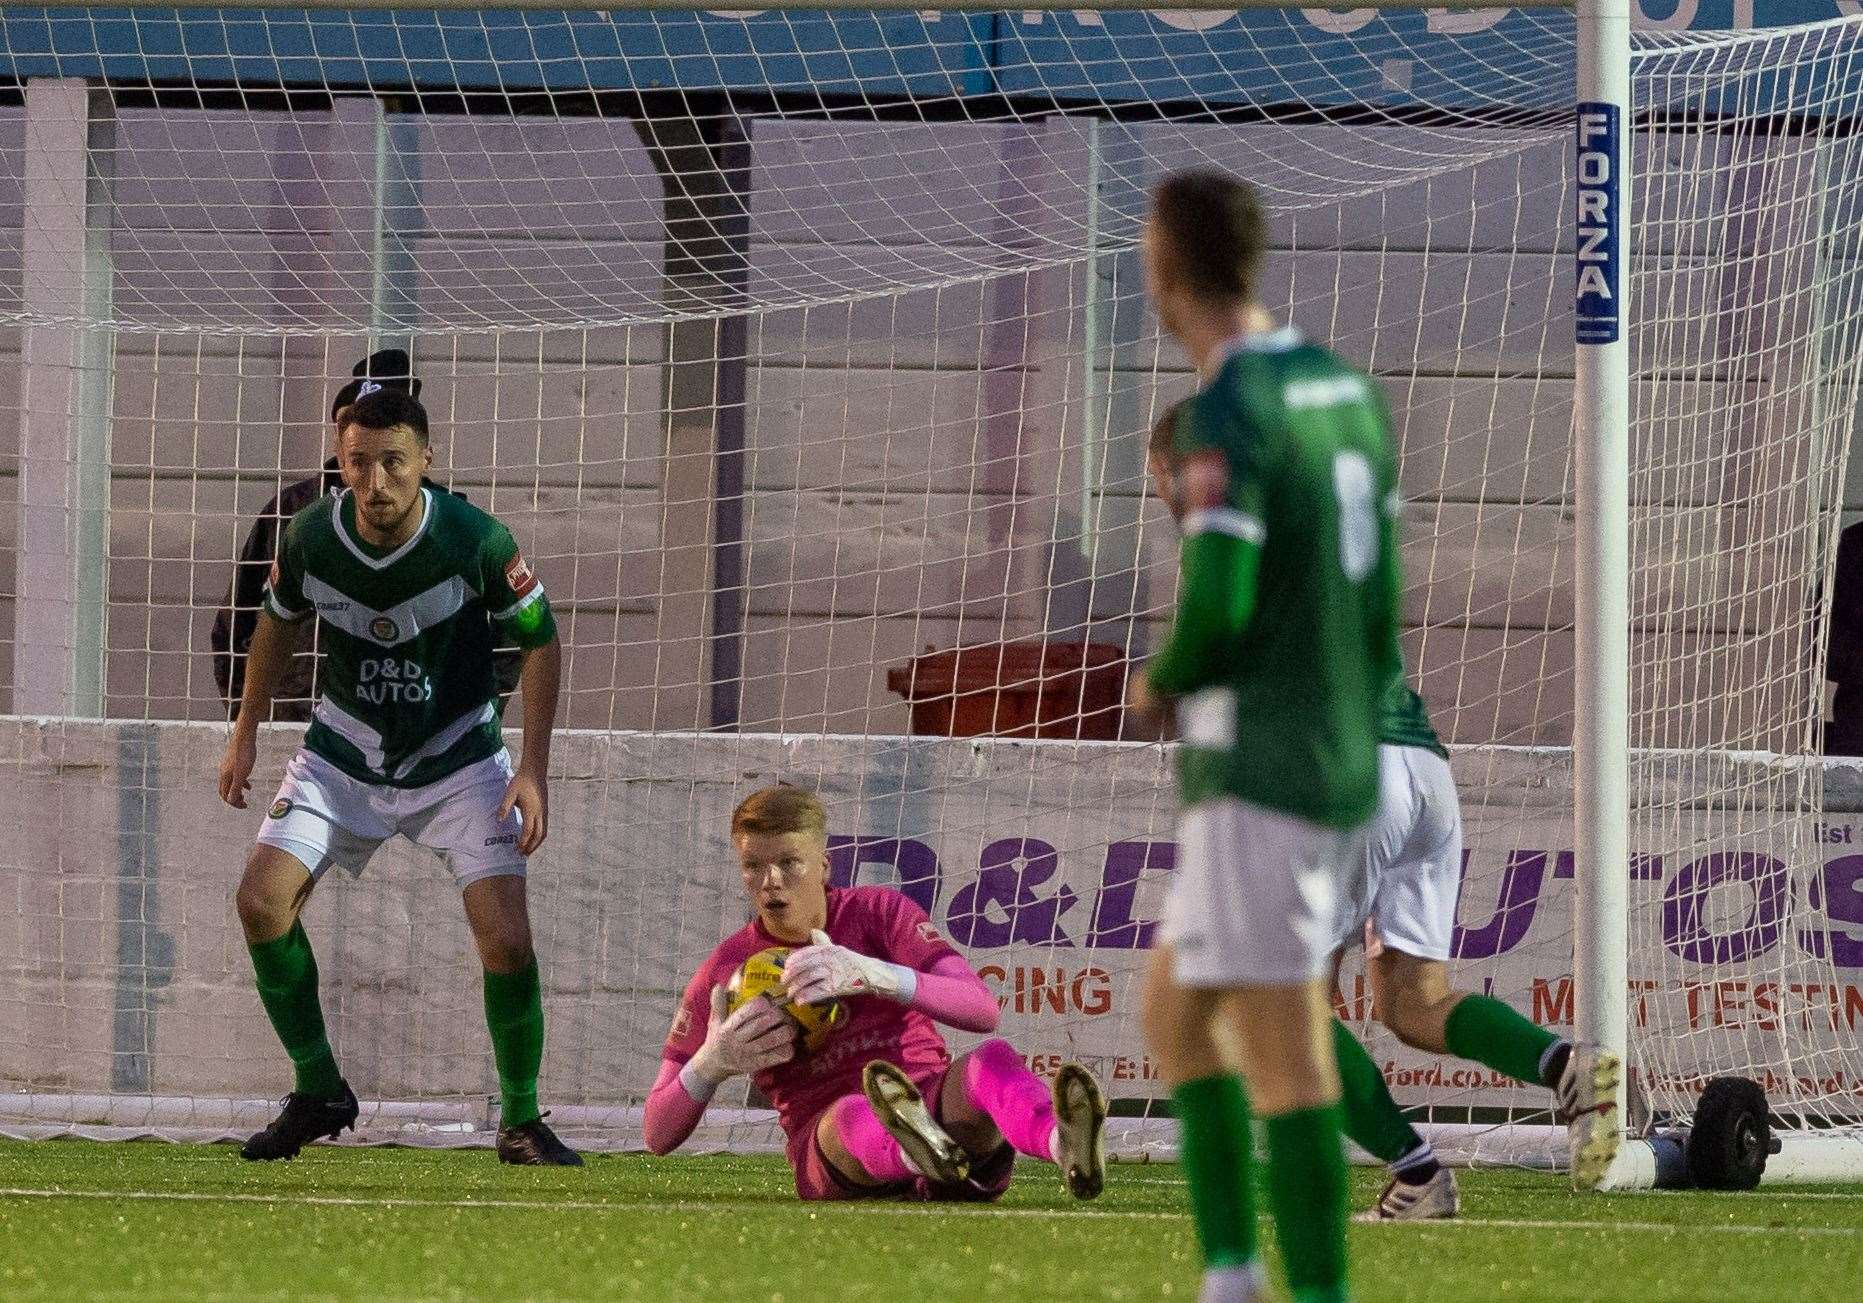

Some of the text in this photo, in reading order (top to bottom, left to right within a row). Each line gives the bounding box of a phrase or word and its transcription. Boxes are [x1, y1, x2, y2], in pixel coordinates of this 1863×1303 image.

[1576, 113, 1612, 299] FORZA
[360, 658, 422, 682] D&D
[357, 676, 432, 704] AUTOS
[1681, 980, 1863, 1031] TESTIN
